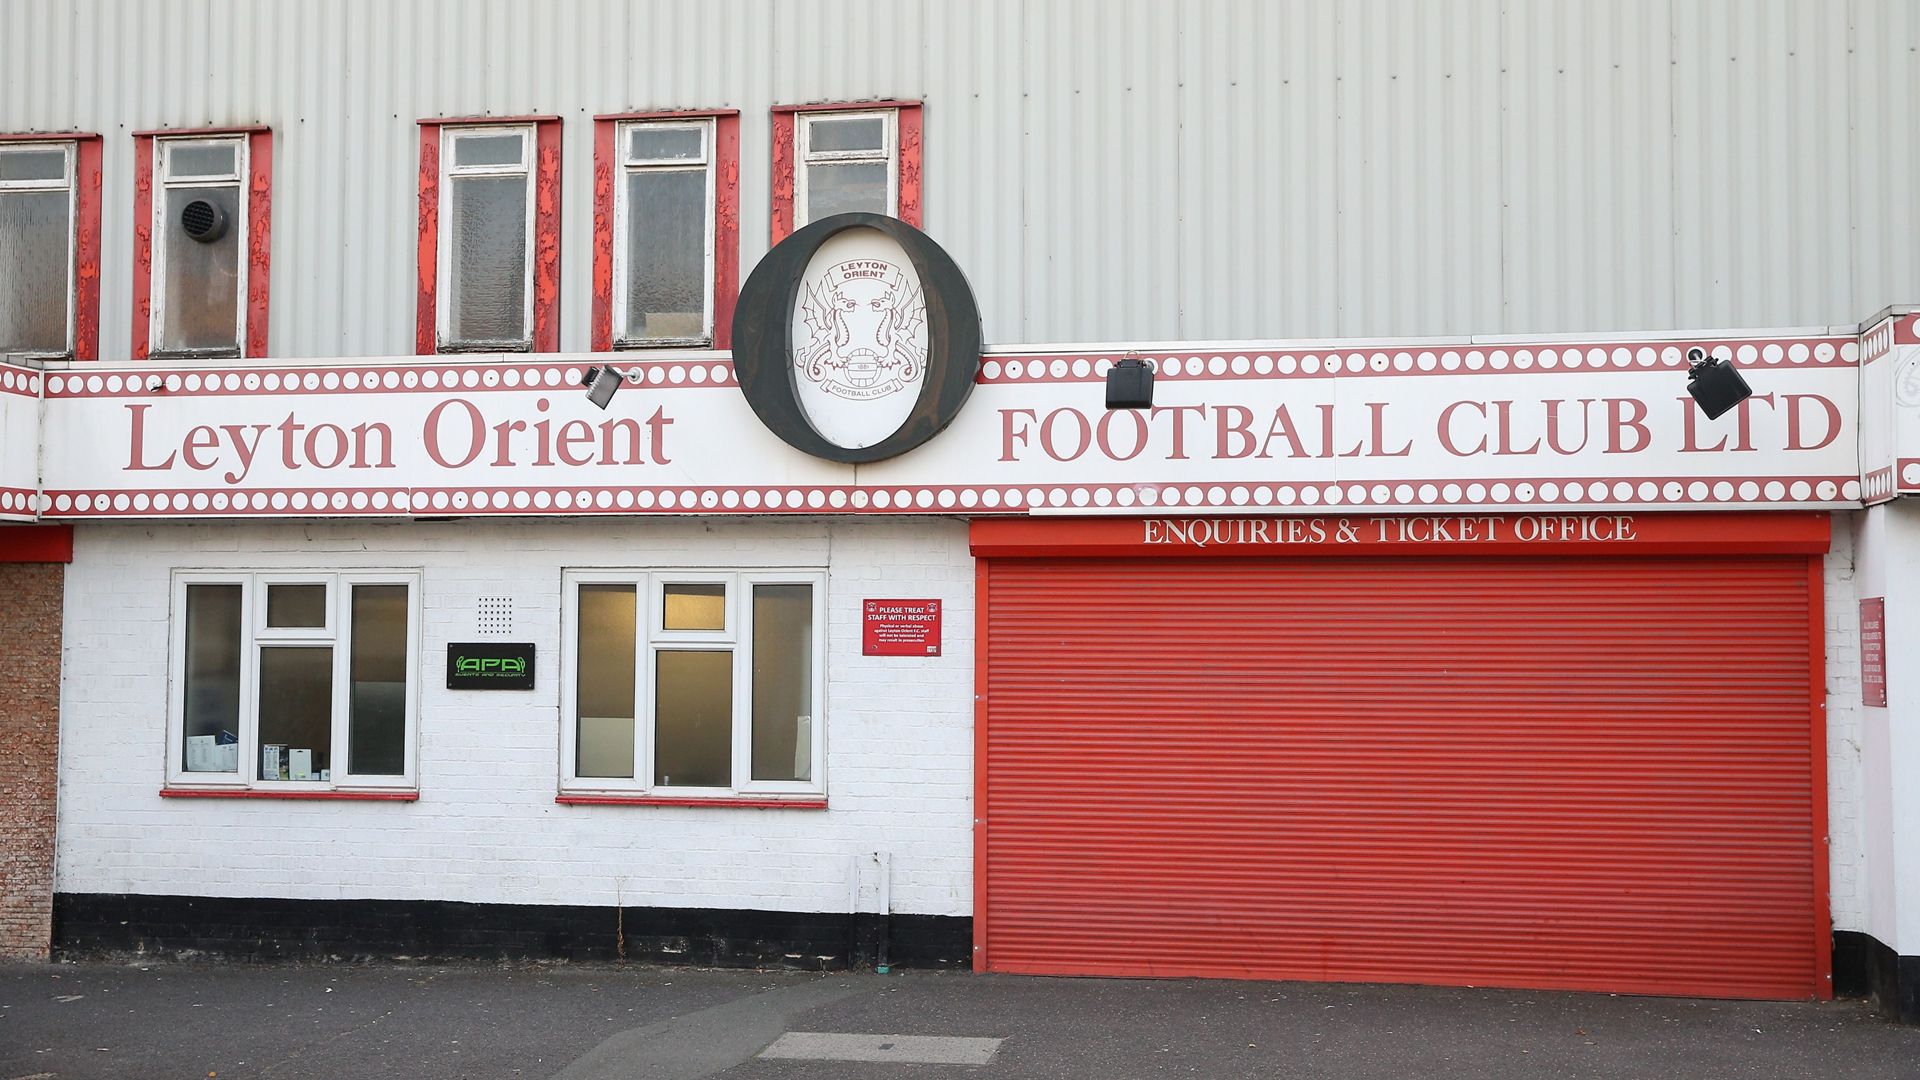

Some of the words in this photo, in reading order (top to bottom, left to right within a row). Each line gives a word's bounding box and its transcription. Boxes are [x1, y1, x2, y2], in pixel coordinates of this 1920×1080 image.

[840, 261, 888, 272] LEYTON
[843, 270, 886, 280] ORIENT
[831, 384, 871, 397] FOOTBALL
[871, 384, 892, 396] CLUB
[997, 402, 1414, 462] FOOTBALL
[1437, 398, 1652, 457] CLUB
[1675, 391, 1842, 453] LTD
[121, 403, 396, 484] Leyton
[422, 398, 674, 468] Orient
[1142, 518, 1327, 548] ENQUIRIES
[1335, 518, 1361, 543] &
[1370, 516, 1505, 543] TICKET
[1514, 515, 1637, 542] OFFICE
[460, 658, 522, 671] APA
